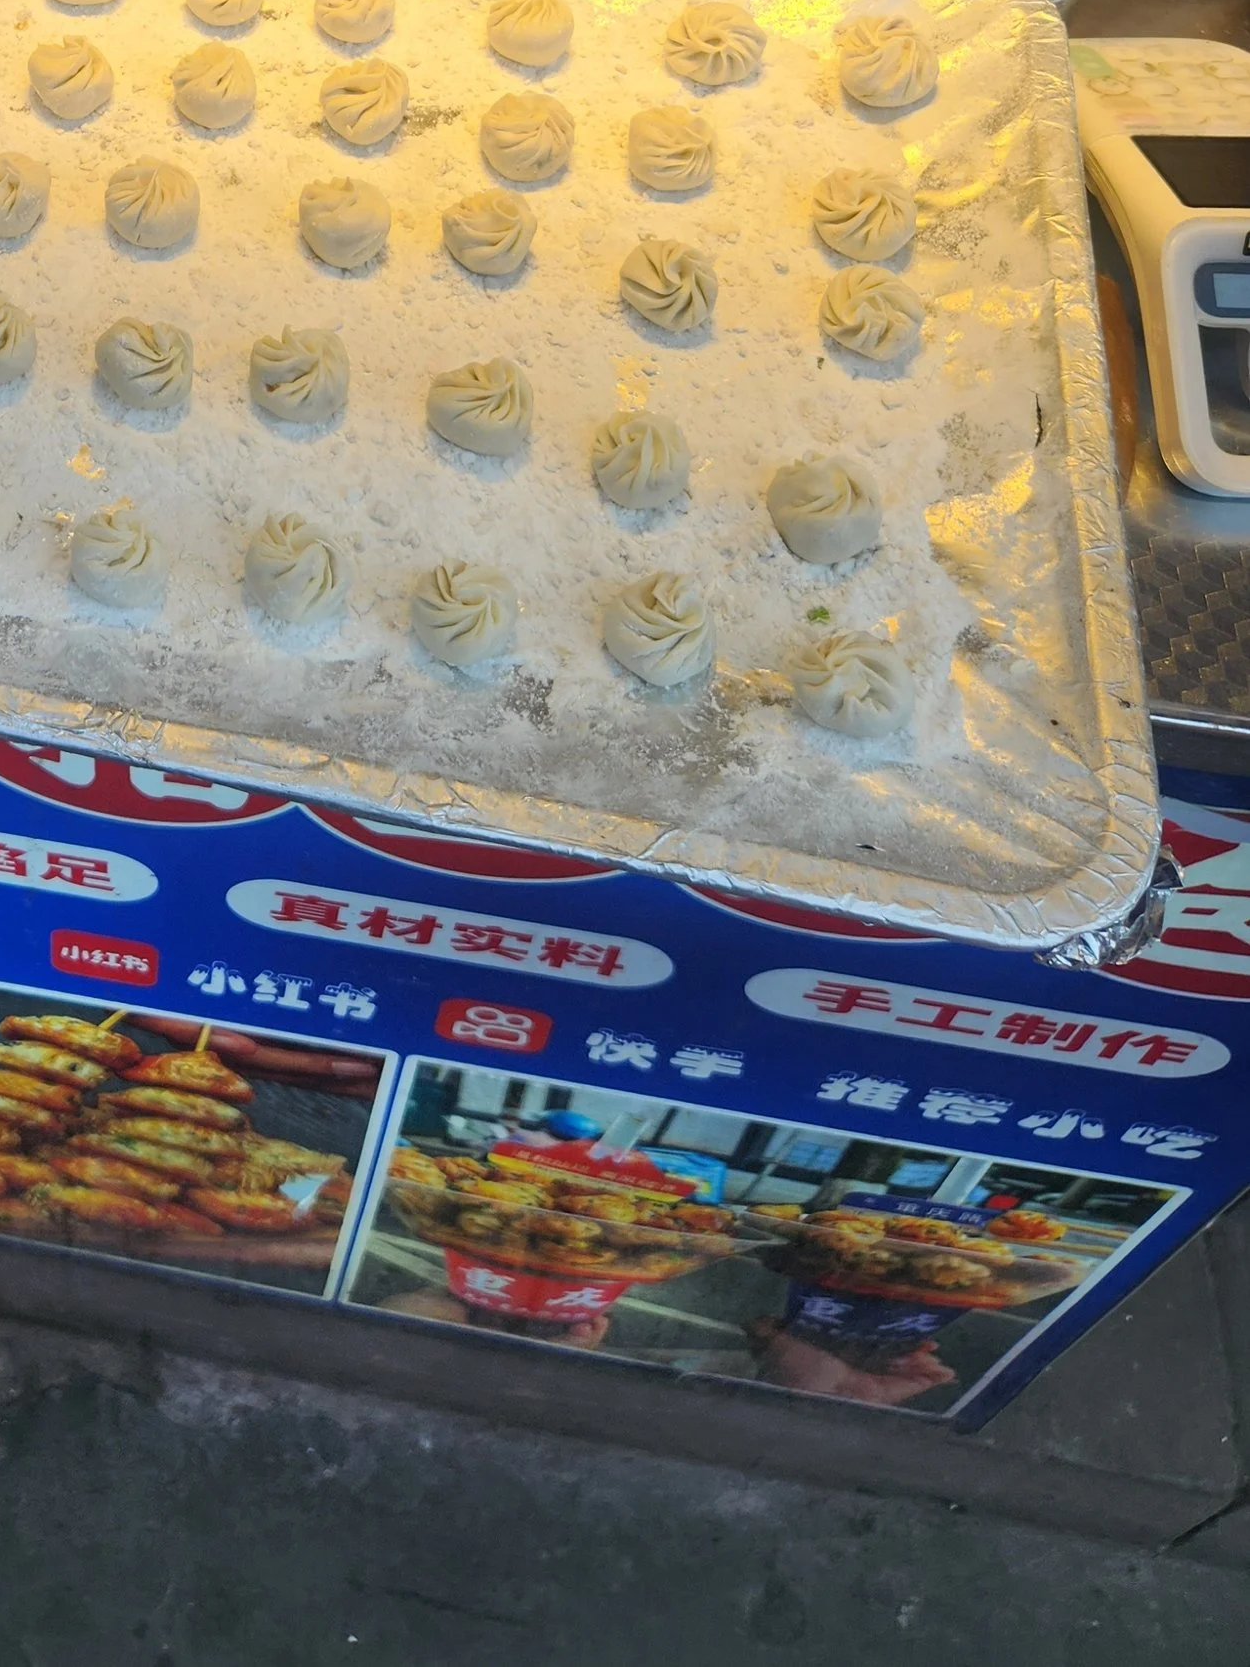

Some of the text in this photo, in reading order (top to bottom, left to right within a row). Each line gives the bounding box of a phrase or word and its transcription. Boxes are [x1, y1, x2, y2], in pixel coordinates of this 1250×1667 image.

[60, 944, 149, 973] 小红书
[270, 890, 626, 978] 真材实料
[188, 960, 378, 1021] 小红书
[803, 980, 1199, 1067] 手工制作
[586, 1028, 744, 1079] 快手
[816, 1070, 1221, 1160] 推荐小吃
